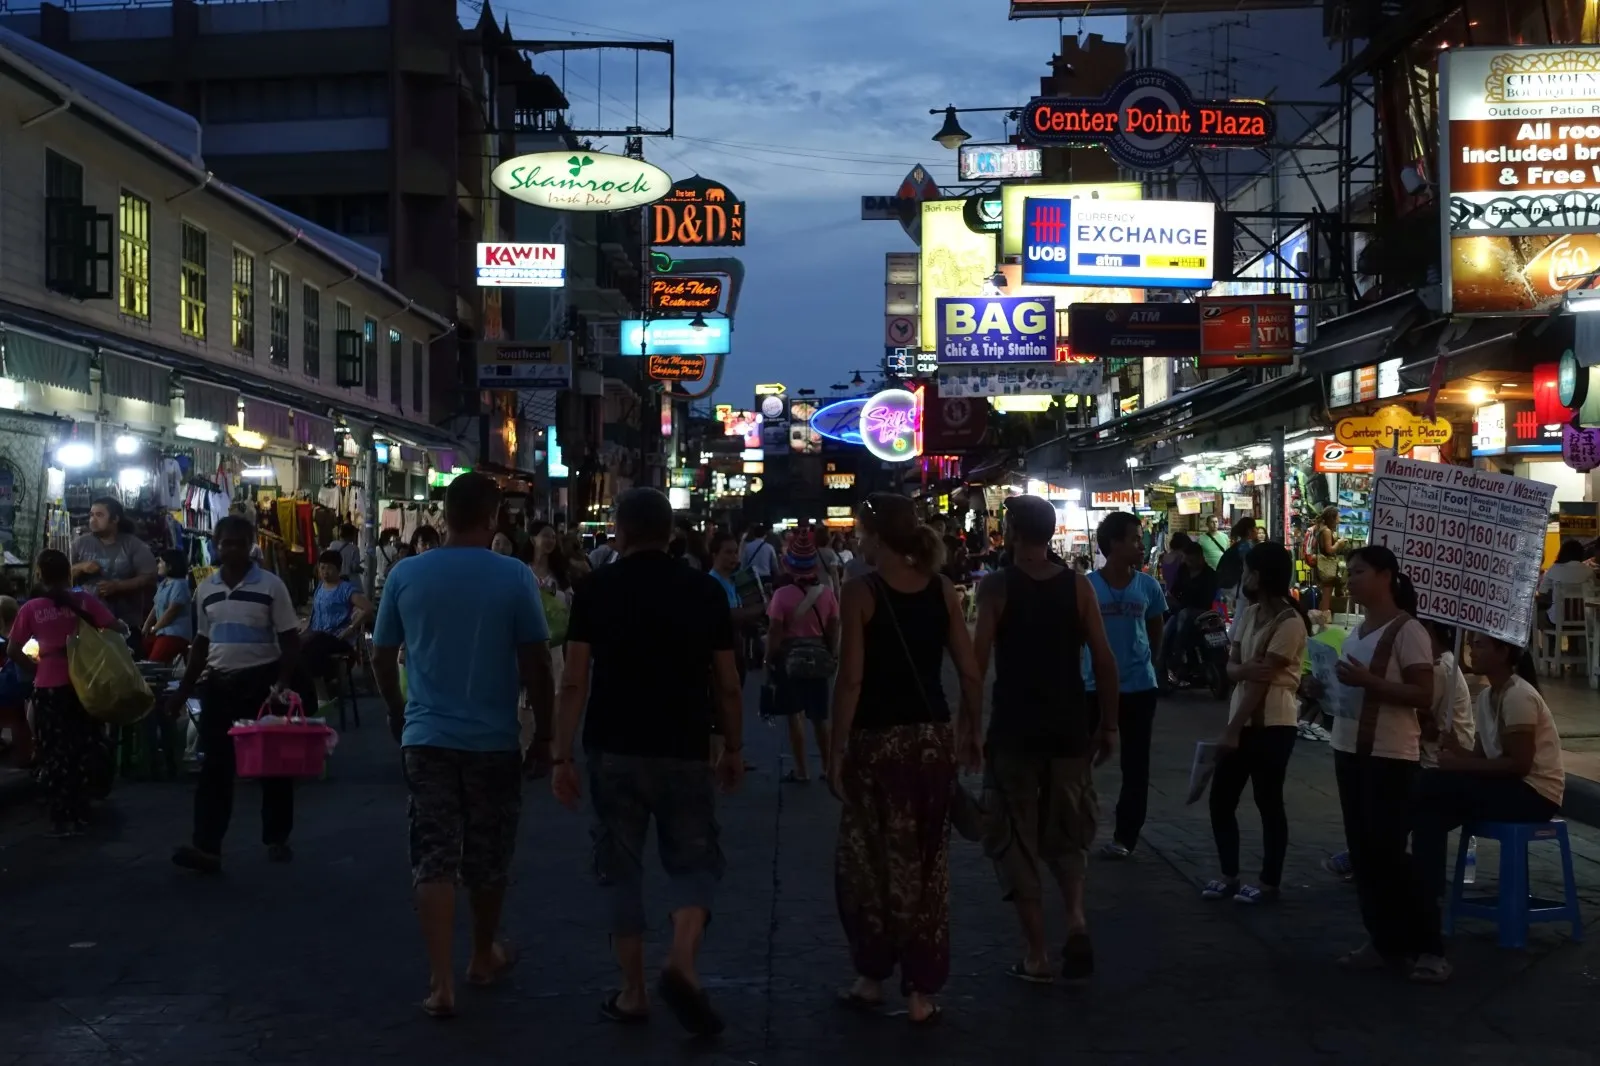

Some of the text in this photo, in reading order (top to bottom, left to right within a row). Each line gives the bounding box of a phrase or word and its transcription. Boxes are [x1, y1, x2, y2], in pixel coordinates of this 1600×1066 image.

[1135, 77, 1168, 88] HOTEL
[1034, 106, 1266, 136] Center Point Plaza
[1488, 106, 1544, 117] Outdoor
[1550, 105, 1584, 115] Patio
[1516, 122, 1551, 141] All
[1114, 133, 1188, 160] SHOPPING MALL
[1462, 143, 1568, 164] included
[1009, 150, 1042, 171] BEER
[509, 165, 652, 193] Shamrock
[1498, 167, 1519, 185] &
[1528, 166, 1586, 185] Free
[547, 191, 613, 206] Irish Pub
[653, 204, 727, 243] D&D
[731, 203, 742, 241] INN
[1077, 211, 1136, 223] CURRENCY
[1077, 225, 1207, 246] EXCHANGE
[485, 246, 556, 266] KAWIN
[1028, 245, 1067, 262] UOB
[1095, 254, 1123, 267] atm
[653, 281, 718, 295] Pick-Thai
[945, 301, 1047, 335] BAG
[1129, 311, 1161, 322] ATM
[1110, 337, 1156, 348] Exchange
[1257, 327, 1289, 342] ATM
[497, 348, 550, 359] Southeast
[945, 342, 968, 357] Chic
[970, 343, 980, 356] &
[982, 342, 1005, 359] Trip
[1008, 341, 1047, 356] Station
[1340, 421, 1447, 440] Center Pint Plaza
[1385, 459, 1444, 482] Manicure
[1454, 470, 1505, 494] Pedicure
[1390, 482, 1408, 491] Type
[1095, 491, 1140, 503] HENNA
[1379, 494, 1396, 503] Time
[1413, 486, 1439, 501] Thai
[1444, 491, 1468, 506] Foot
[1478, 505, 1491, 513] Oil
[1408, 513, 1435, 533] 130
[1440, 518, 1466, 539] 130
[1380, 534, 1388, 548] 1
[1470, 524, 1493, 545] 160
[1497, 530, 1517, 551] 140
[1405, 538, 1433, 559] 230
[1436, 544, 1463, 565] 230
[1465, 552, 1489, 572] 300
[1492, 556, 1513, 578] 260
[1404, 564, 1430, 585] 350
[1433, 570, 1460, 591] 350
[1462, 578, 1486, 599] 400
[1488, 583, 1510, 604] 350
[1431, 595, 1459, 617] 430
[1460, 602, 1483, 624] 500
[1486, 609, 1506, 631] 450
